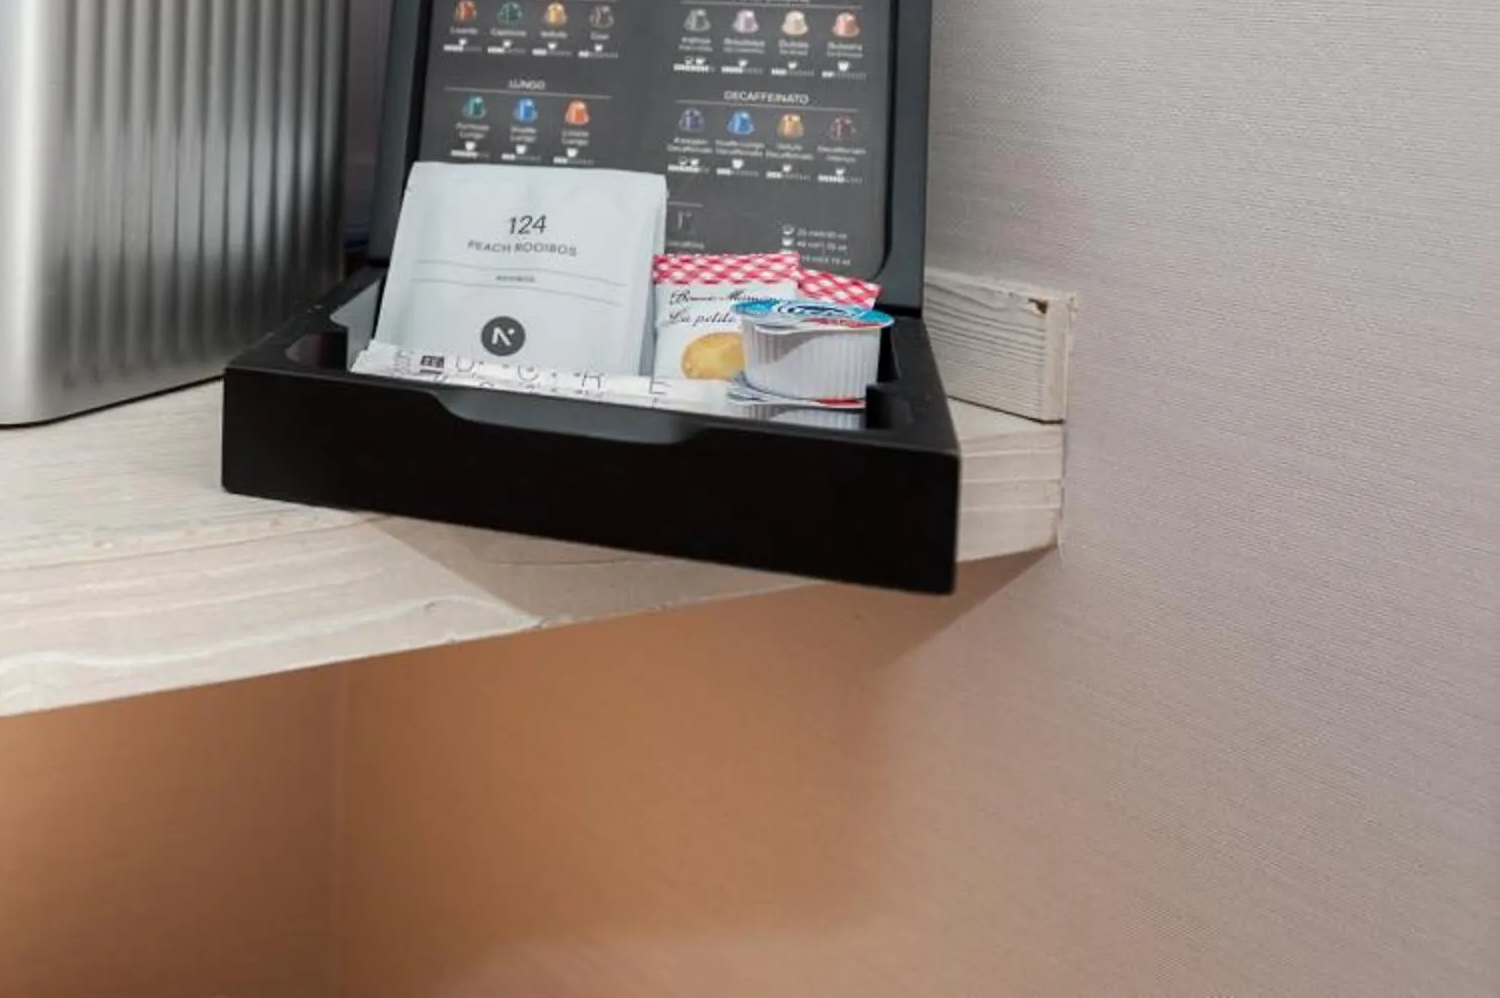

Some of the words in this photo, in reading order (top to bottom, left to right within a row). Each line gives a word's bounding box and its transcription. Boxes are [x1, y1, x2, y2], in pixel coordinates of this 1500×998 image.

[723, 90, 810, 104] DECAFFEINATO
[509, 214, 547, 235] 124
[467, 239, 512, 255] PEACH
